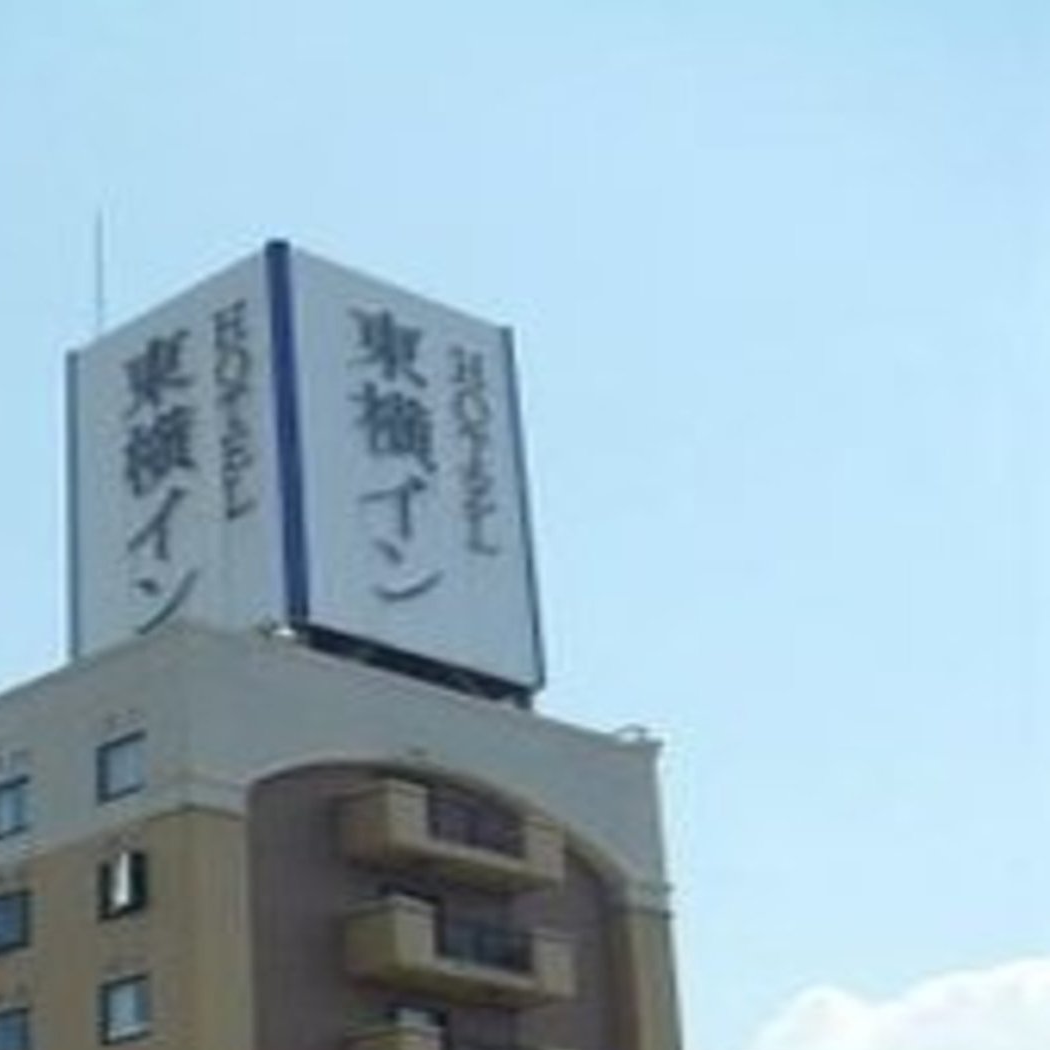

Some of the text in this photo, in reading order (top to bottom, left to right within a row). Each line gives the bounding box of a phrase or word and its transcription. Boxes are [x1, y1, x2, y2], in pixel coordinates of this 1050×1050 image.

[123, 328, 200, 635] 東横イン
[212, 299, 254, 520] HOTEL
[350, 307, 444, 602] 東横イン
[451, 347, 499, 557] HOTEL
